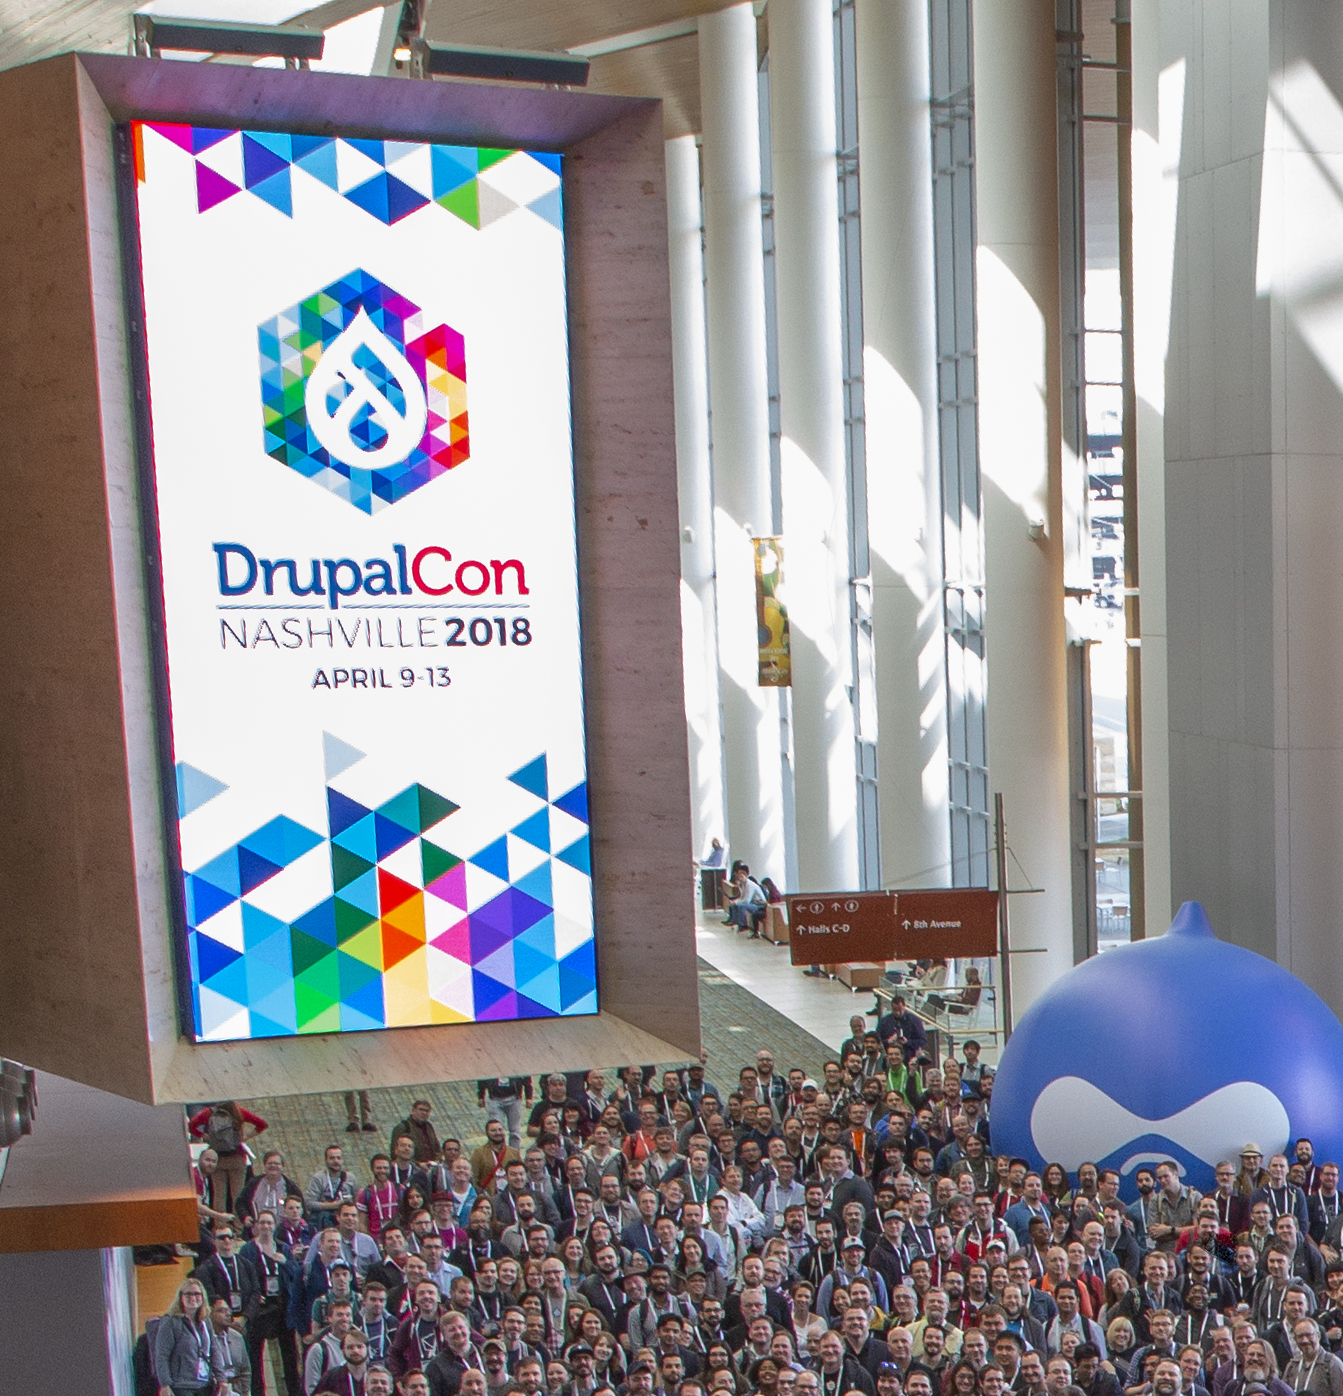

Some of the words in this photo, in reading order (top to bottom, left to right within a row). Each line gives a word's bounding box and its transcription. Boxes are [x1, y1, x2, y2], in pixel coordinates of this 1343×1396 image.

[212, 541, 530, 610] DrupalCon
[219, 616, 438, 649] NASHVILLE
[444, 616, 533, 647] 2018
[311, 666, 393, 690] APRIL
[399, 665, 452, 689] 9-13
[808, 925, 831, 934] Halls
[832, 923, 850, 933] C-D
[913, 920, 928, 929] 8th
[930, 920, 962, 929] Avenue
